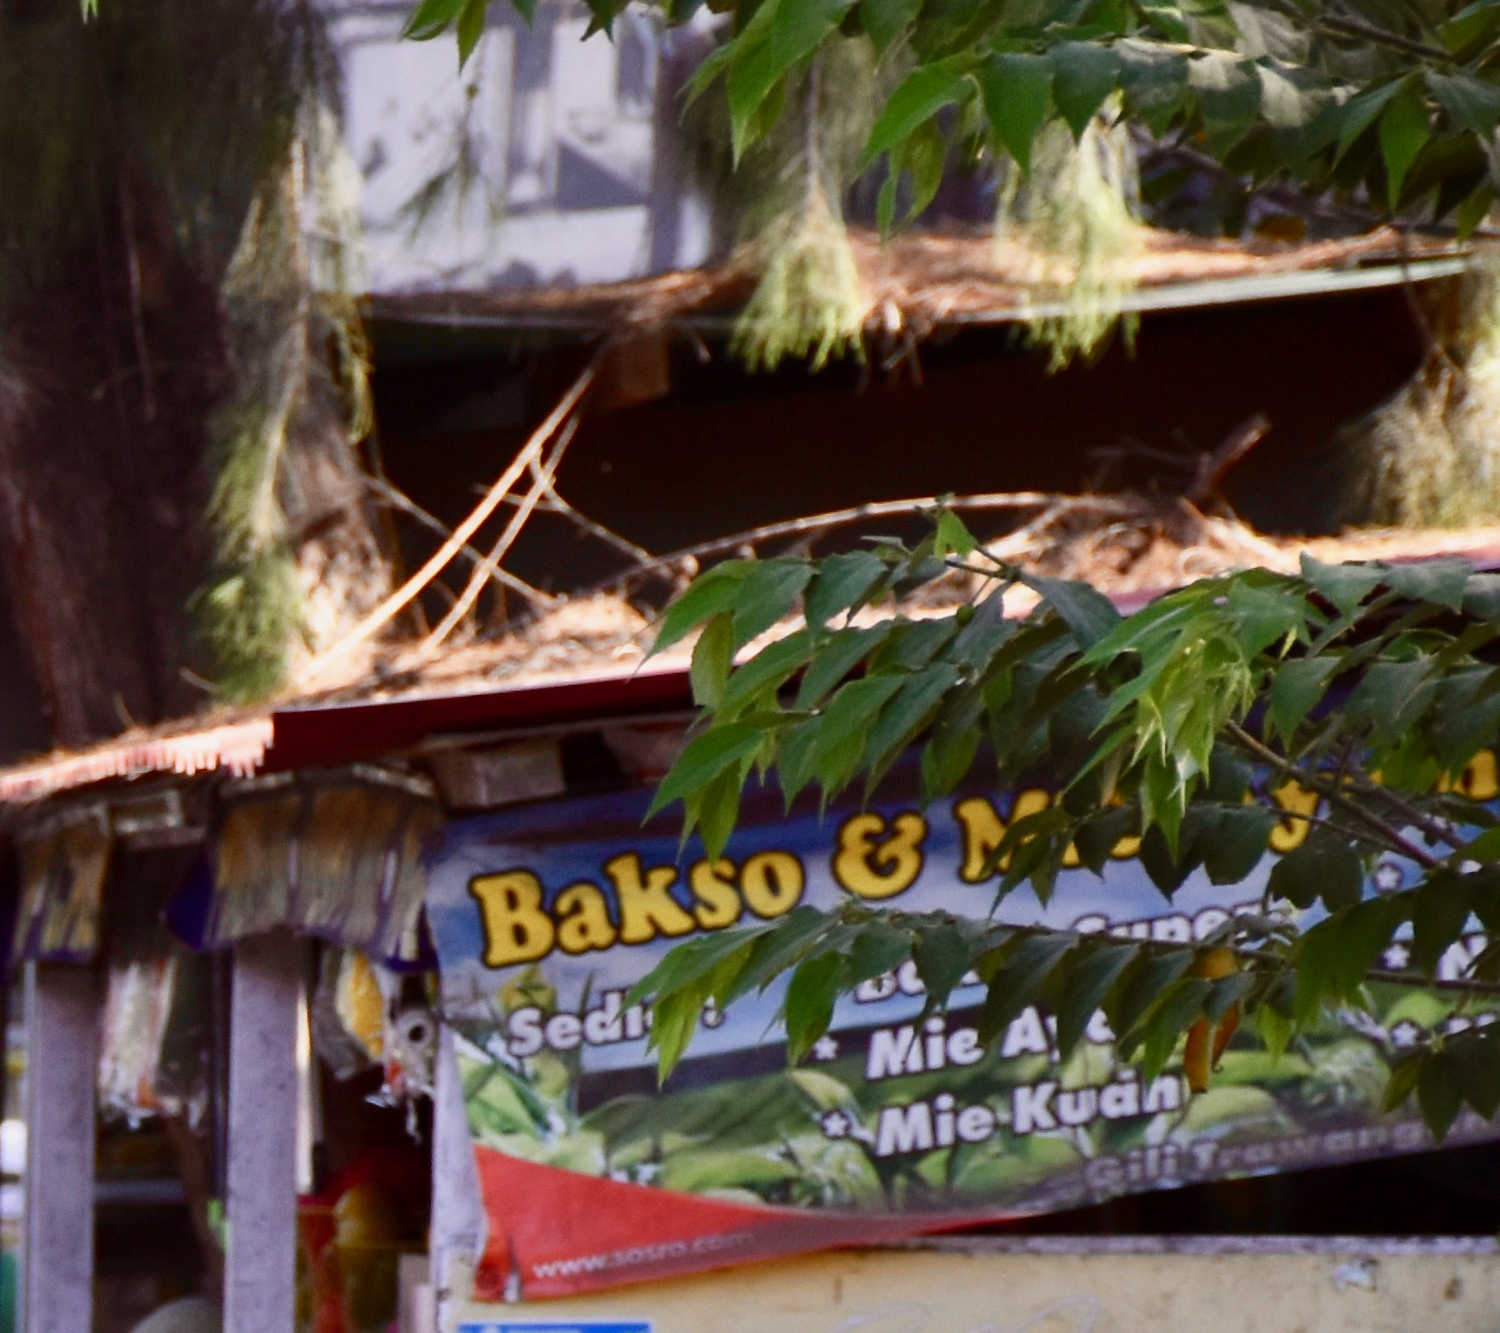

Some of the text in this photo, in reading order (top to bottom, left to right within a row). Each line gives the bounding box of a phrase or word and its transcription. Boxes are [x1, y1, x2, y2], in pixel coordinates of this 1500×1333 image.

[470, 850, 804, 968] Bakso
[832, 813, 927, 899] &
[865, 1016, 985, 1081] Mie
[875, 1092, 997, 1158] Mie
